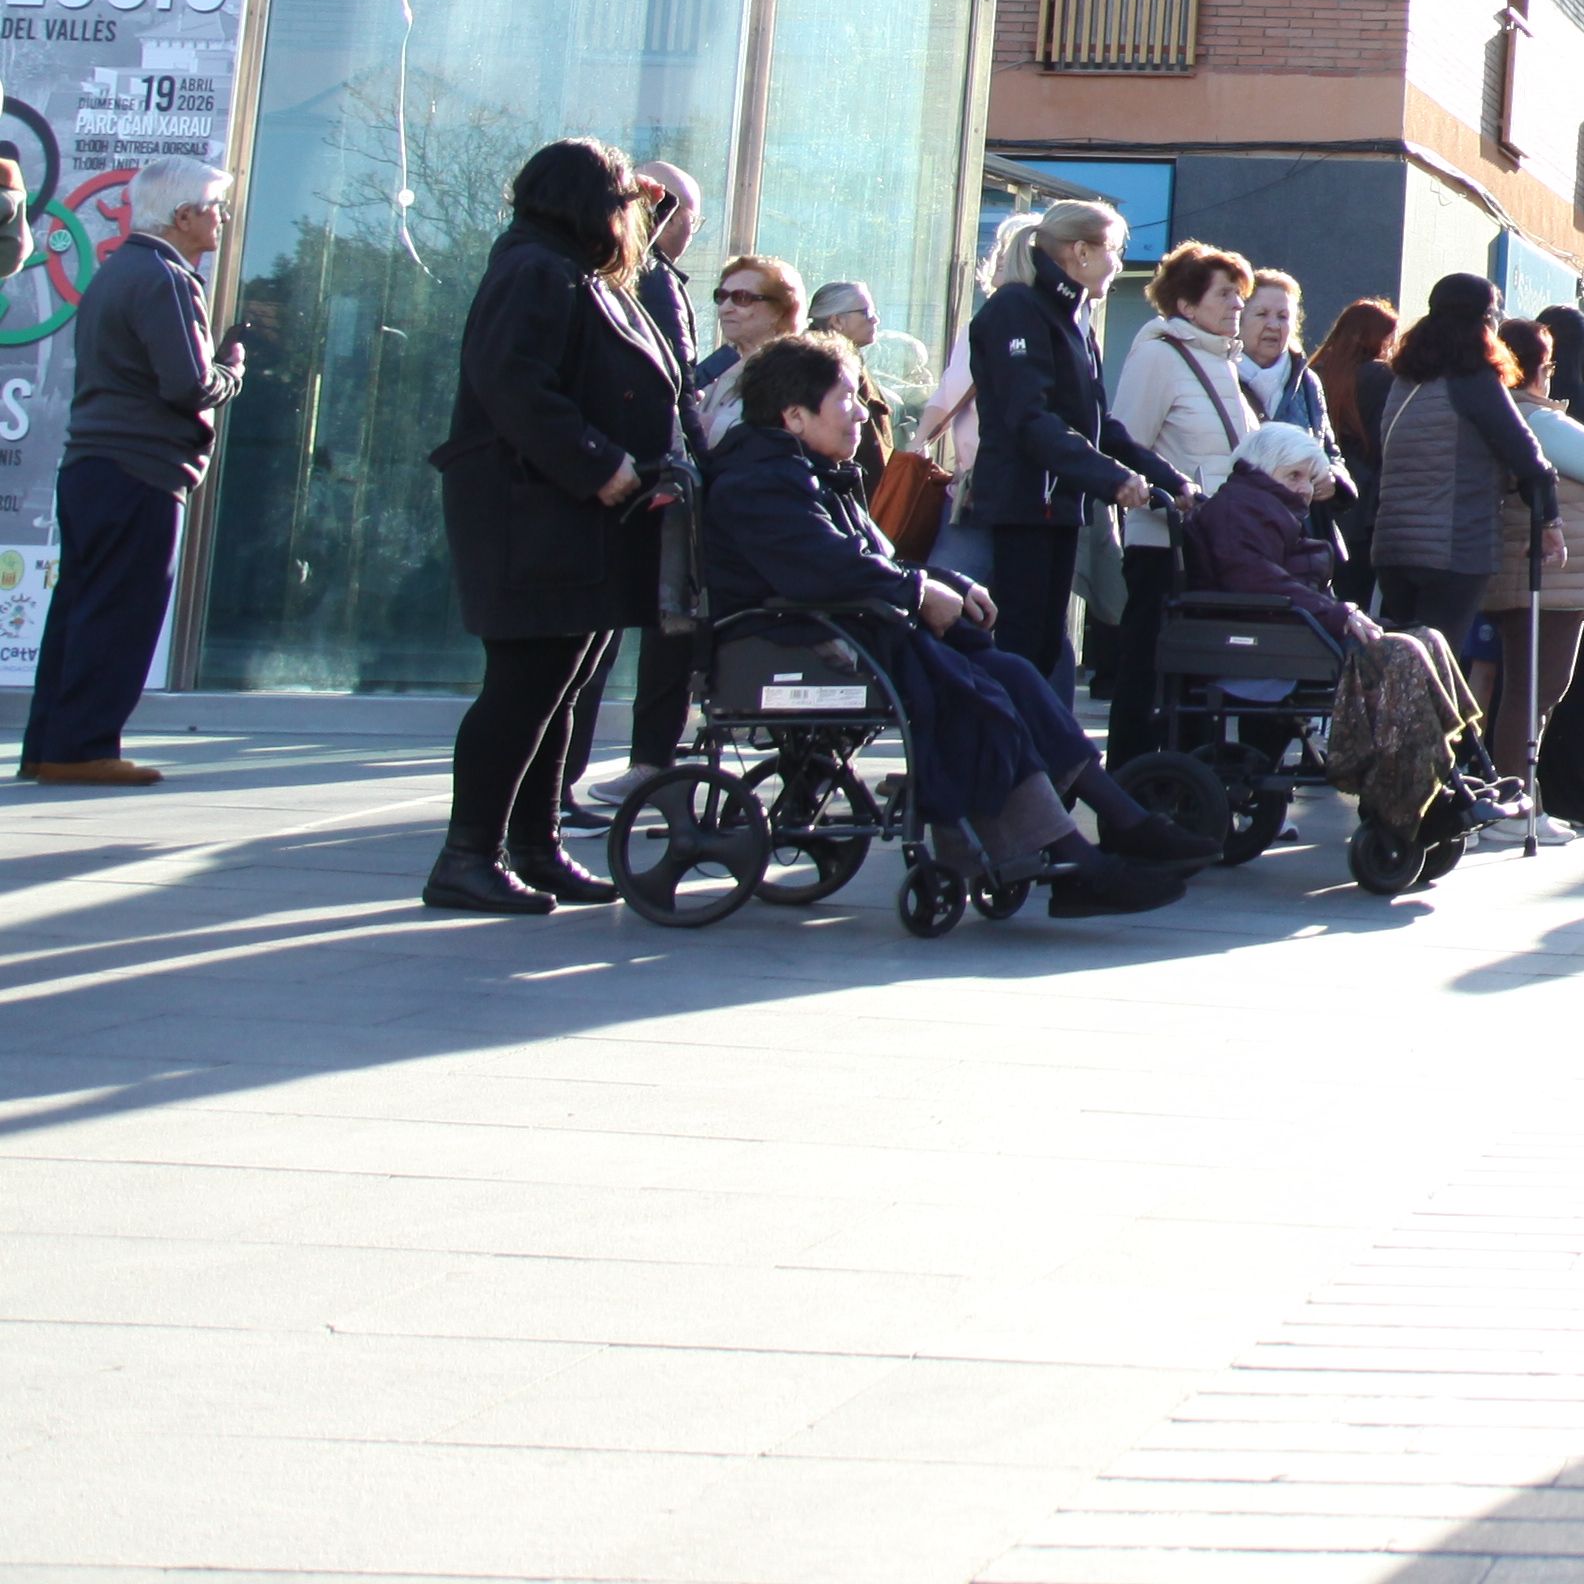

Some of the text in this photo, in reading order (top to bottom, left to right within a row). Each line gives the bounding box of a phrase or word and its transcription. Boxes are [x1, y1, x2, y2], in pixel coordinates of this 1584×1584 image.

[1, 13, 116, 42] DEL VALLÈS
[78, 75, 176, 112] DIUMENGE 19
[180, 78, 215, 92] ABRIL
[177, 95, 215, 111] 2026
[75, 114, 212, 137] PARC CAN XARAU
[75, 139, 209, 156] 10:00H ENTREGA DORSALS
